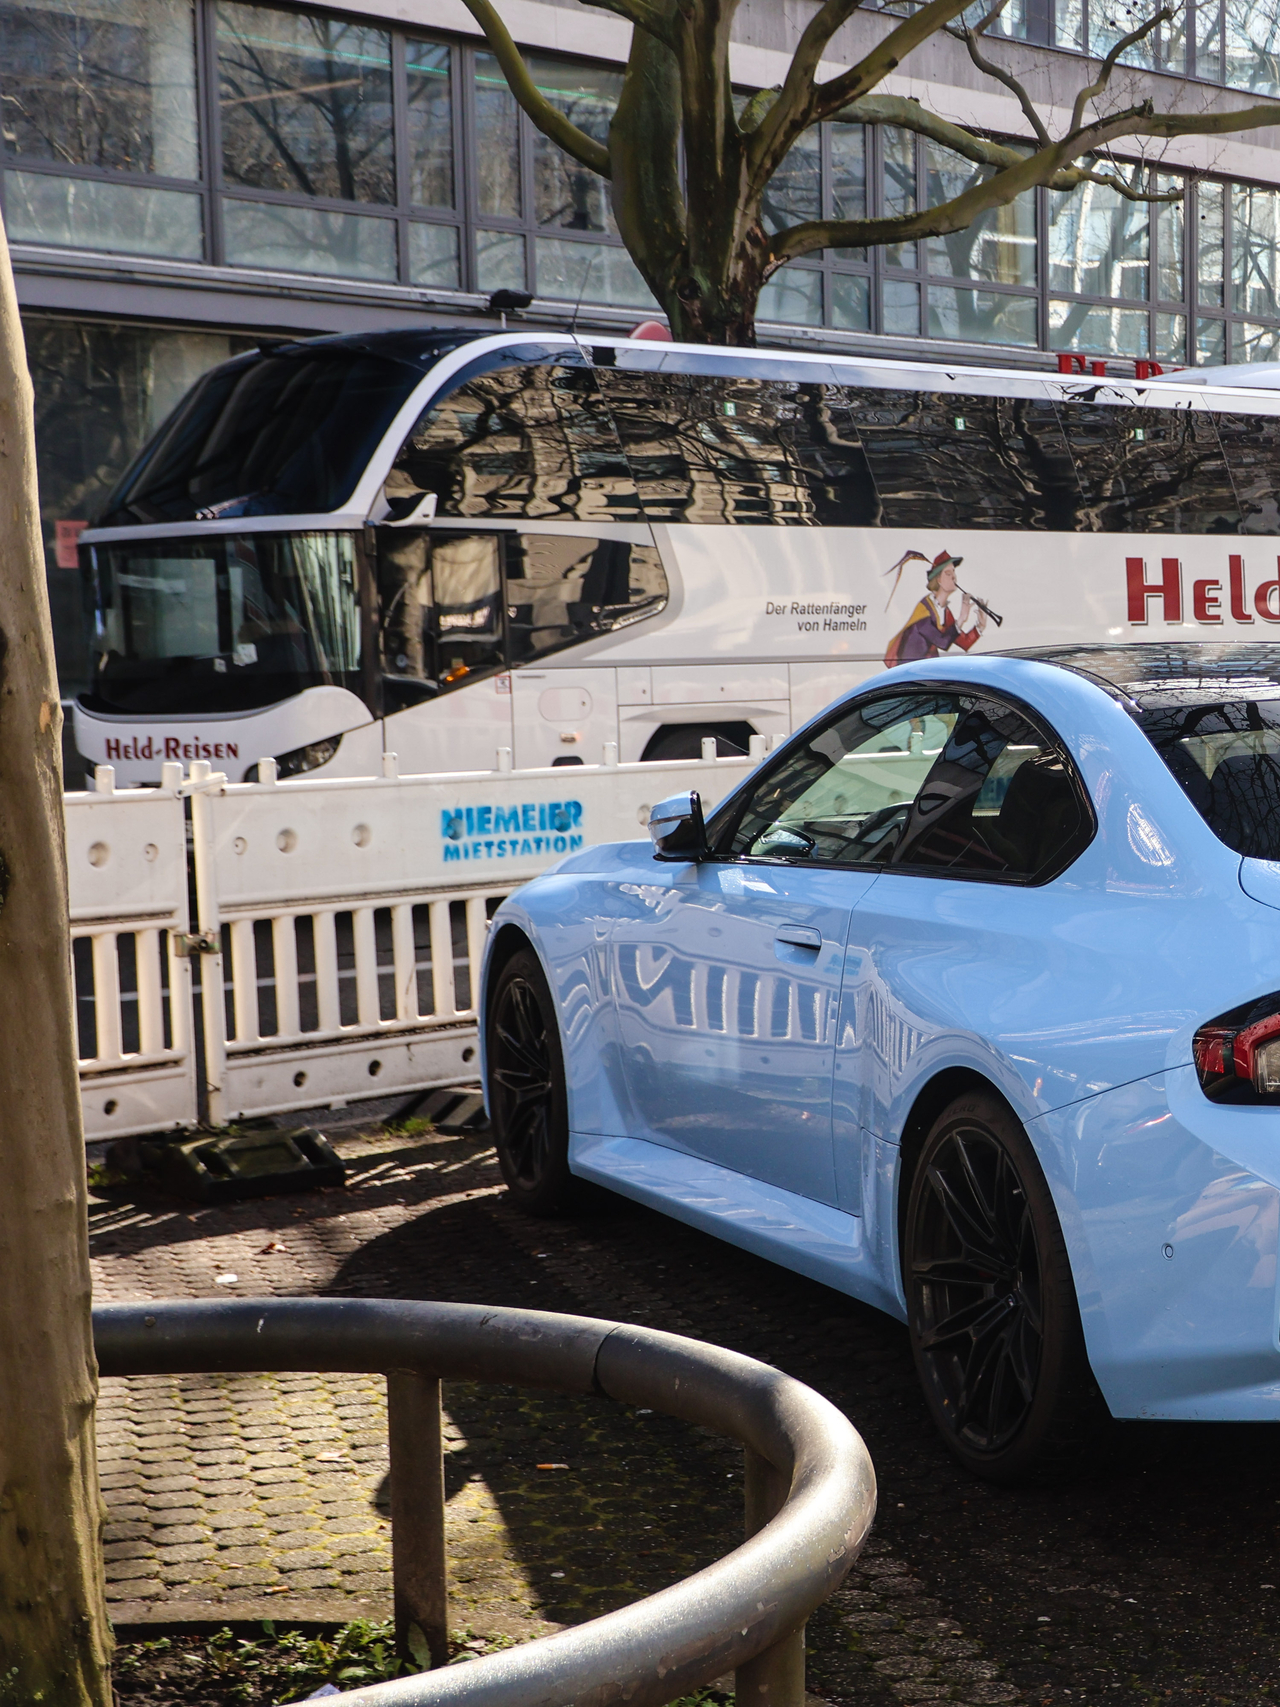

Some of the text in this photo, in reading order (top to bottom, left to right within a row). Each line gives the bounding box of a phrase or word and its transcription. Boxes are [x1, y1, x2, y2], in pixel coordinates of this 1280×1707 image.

[766, 601, 867, 618] Der Rattenfänger
[797, 618, 867, 631] von Hameln
[441, 800, 583, 838] NIEMEIER
[443, 835, 583, 862] MIETSTATION
